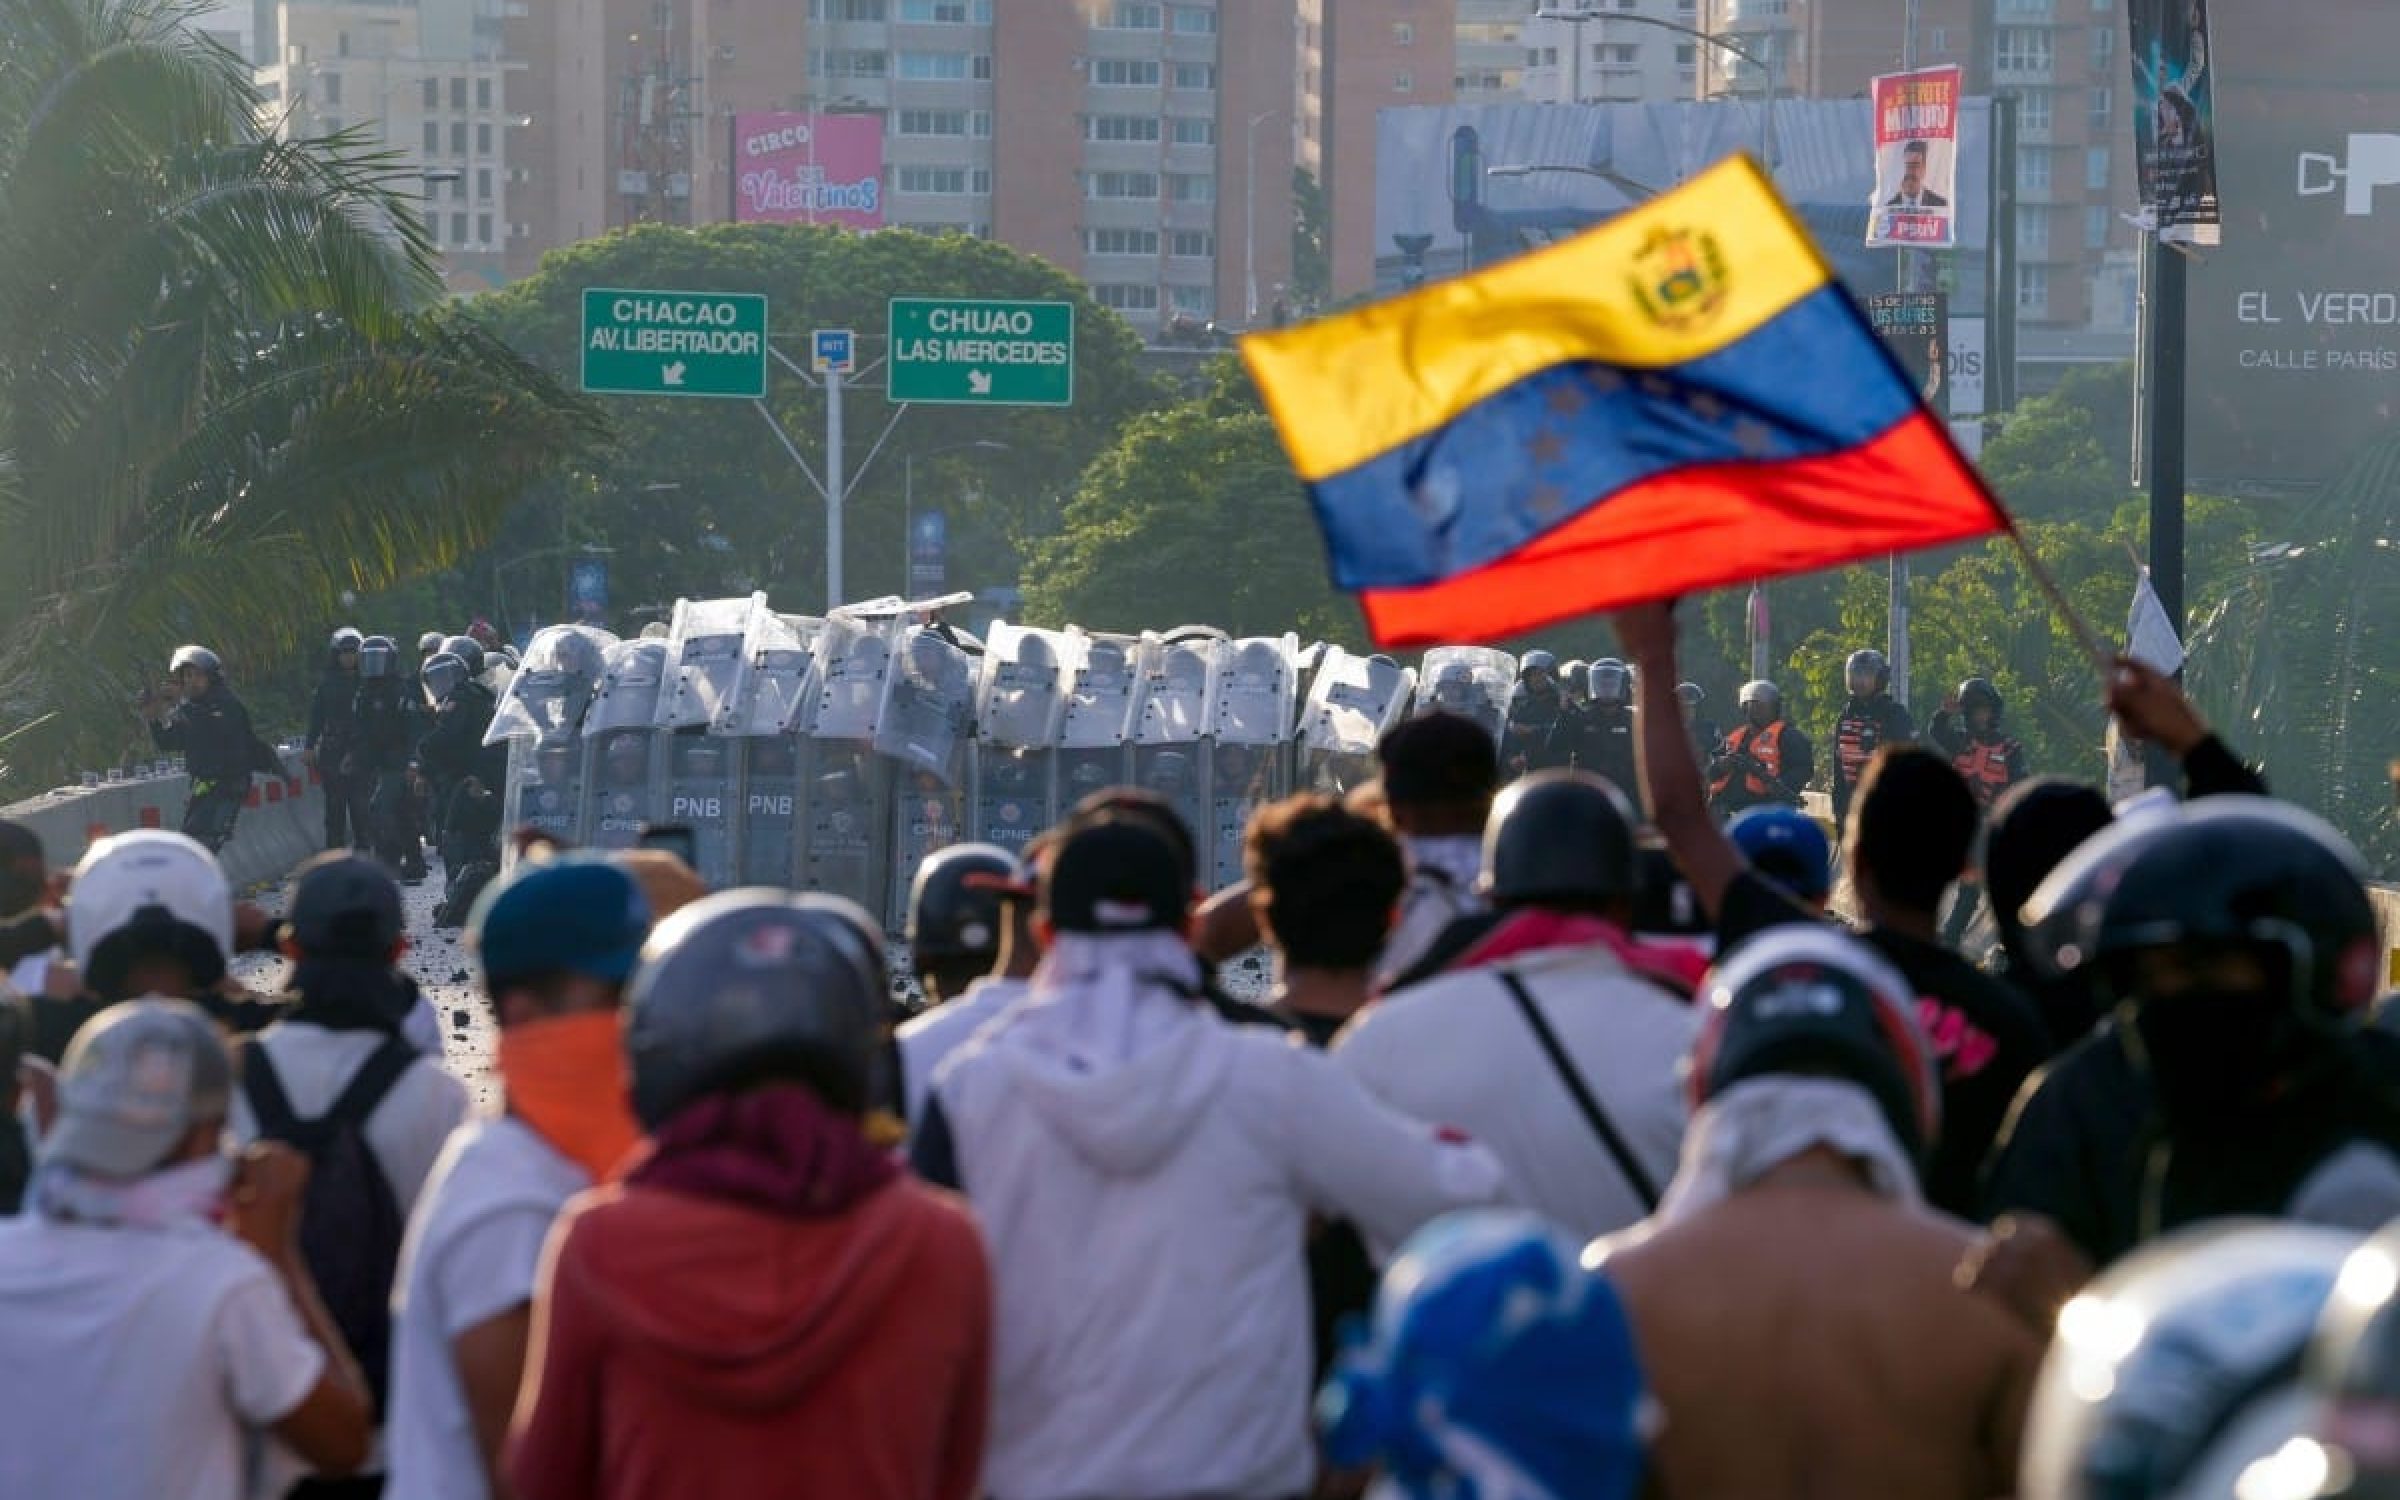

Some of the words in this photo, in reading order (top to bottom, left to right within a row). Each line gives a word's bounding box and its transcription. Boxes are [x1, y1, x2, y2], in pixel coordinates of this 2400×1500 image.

[747, 125, 810, 156] CIRCO
[613, 299, 736, 325] CHACAO
[2238, 291, 2281, 323] EL
[2297, 291, 2400, 323] VERD
[929, 308, 1033, 335] CHUAO
[590, 327, 621, 351] AV.
[624, 328, 760, 356] LIBERTADOR
[896, 338, 943, 361] LAS
[945, 340, 1067, 365] MERCEDES
[2239, 349, 2319, 369] CALLE
[2327, 345, 2397, 369] PARÍS
[673, 797, 721, 817] PNB
[748, 795, 793, 815] PNB
